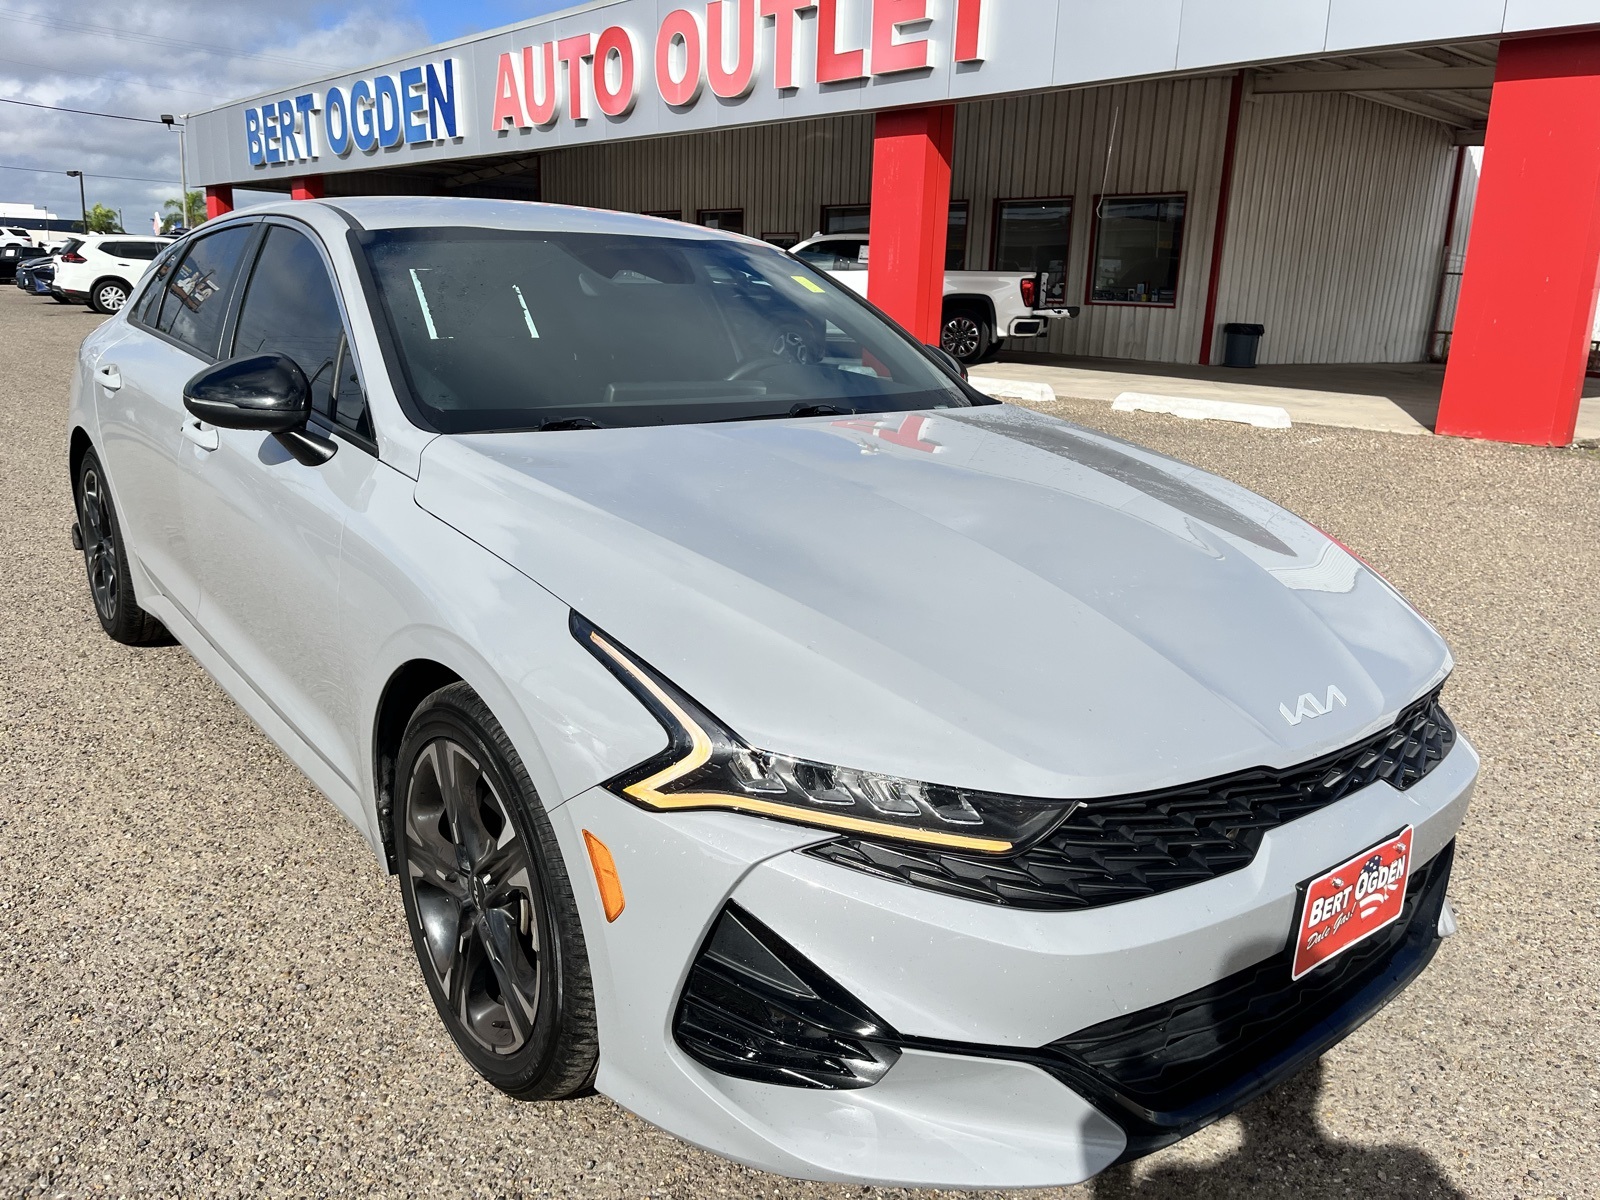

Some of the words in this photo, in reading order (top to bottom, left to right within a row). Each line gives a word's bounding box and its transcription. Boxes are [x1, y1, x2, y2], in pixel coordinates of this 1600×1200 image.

[245, 93, 320, 166] BERT
[325, 58, 463, 156] OGDEN
[492, 25, 638, 131] AUTO
[1279, 684, 1347, 726] KIA
[1308, 885, 1353, 929] BERT
[1355, 854, 1406, 900] OGDEN
[1306, 925, 1331, 950] Dale
